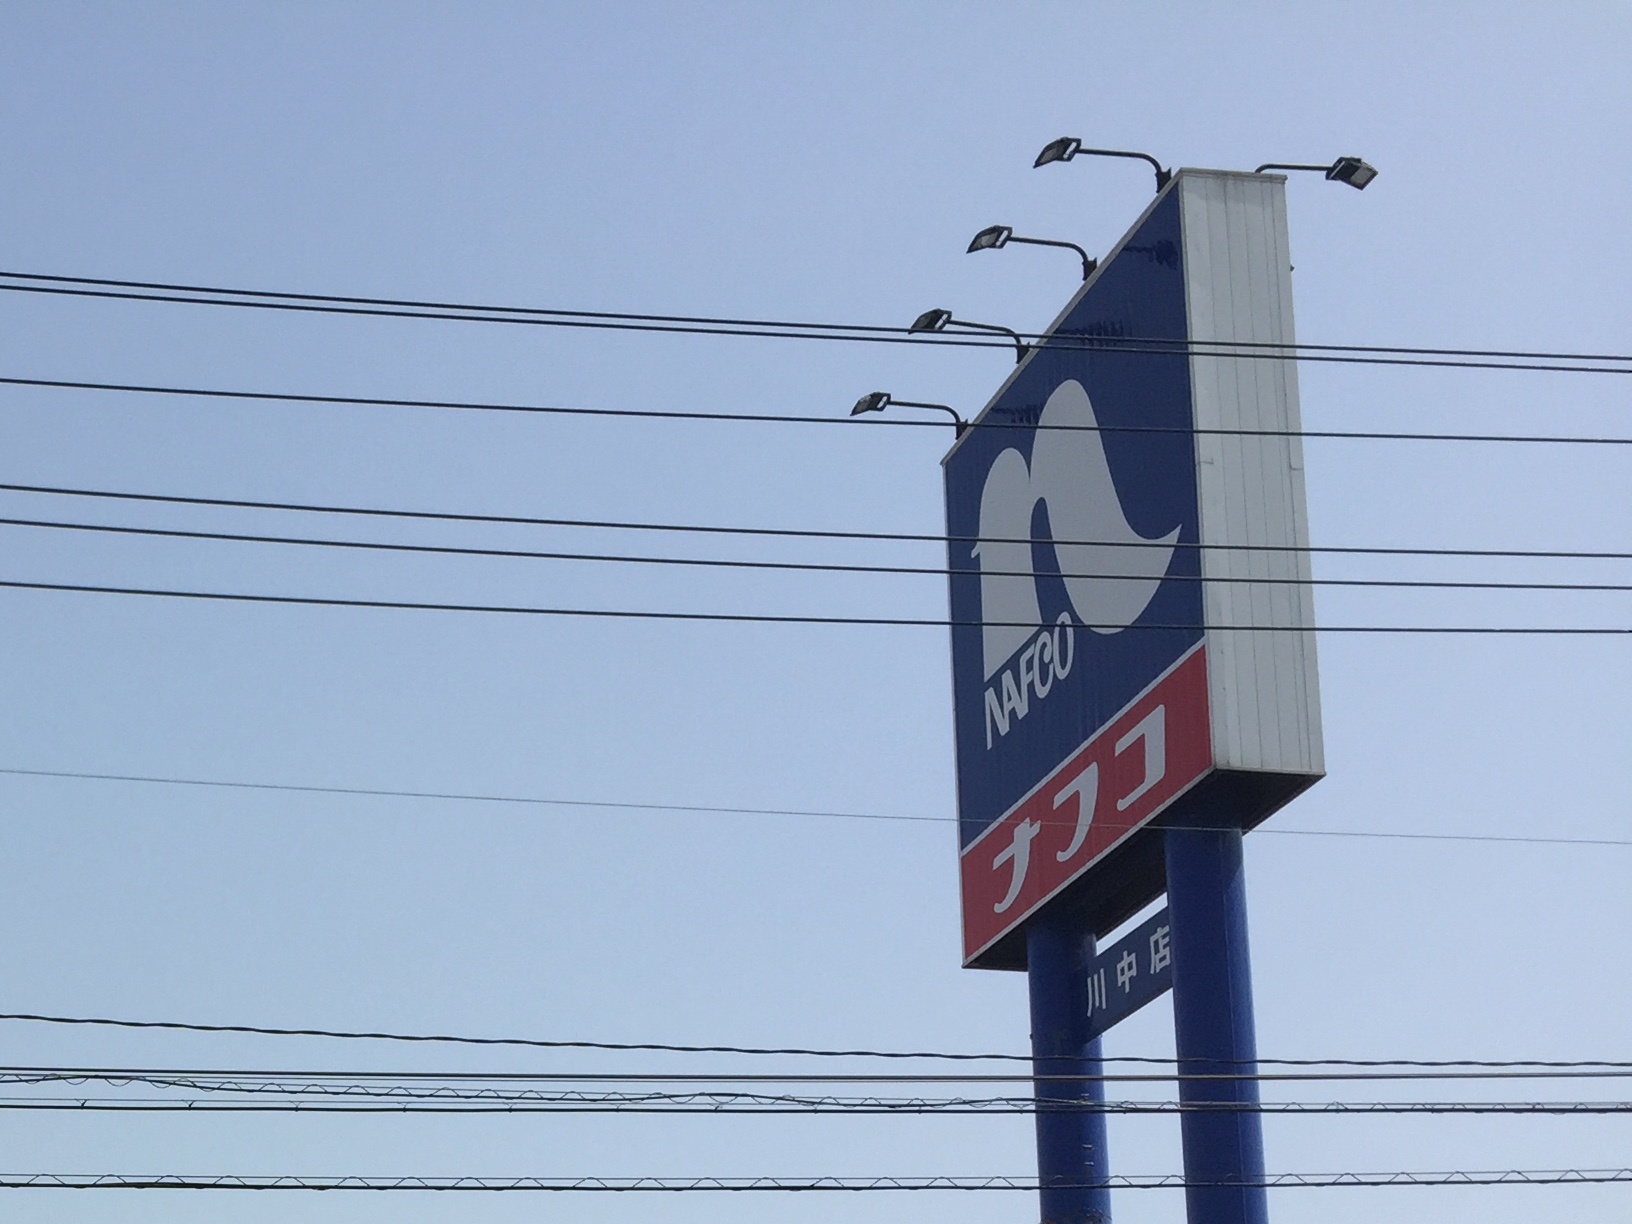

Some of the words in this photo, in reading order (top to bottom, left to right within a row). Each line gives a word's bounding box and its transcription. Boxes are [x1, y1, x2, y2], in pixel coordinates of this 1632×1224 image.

[984, 611, 1074, 750] NAFCO
[992, 704, 1166, 913] ナフコ
[1087, 924, 1171, 1017] 川中店
